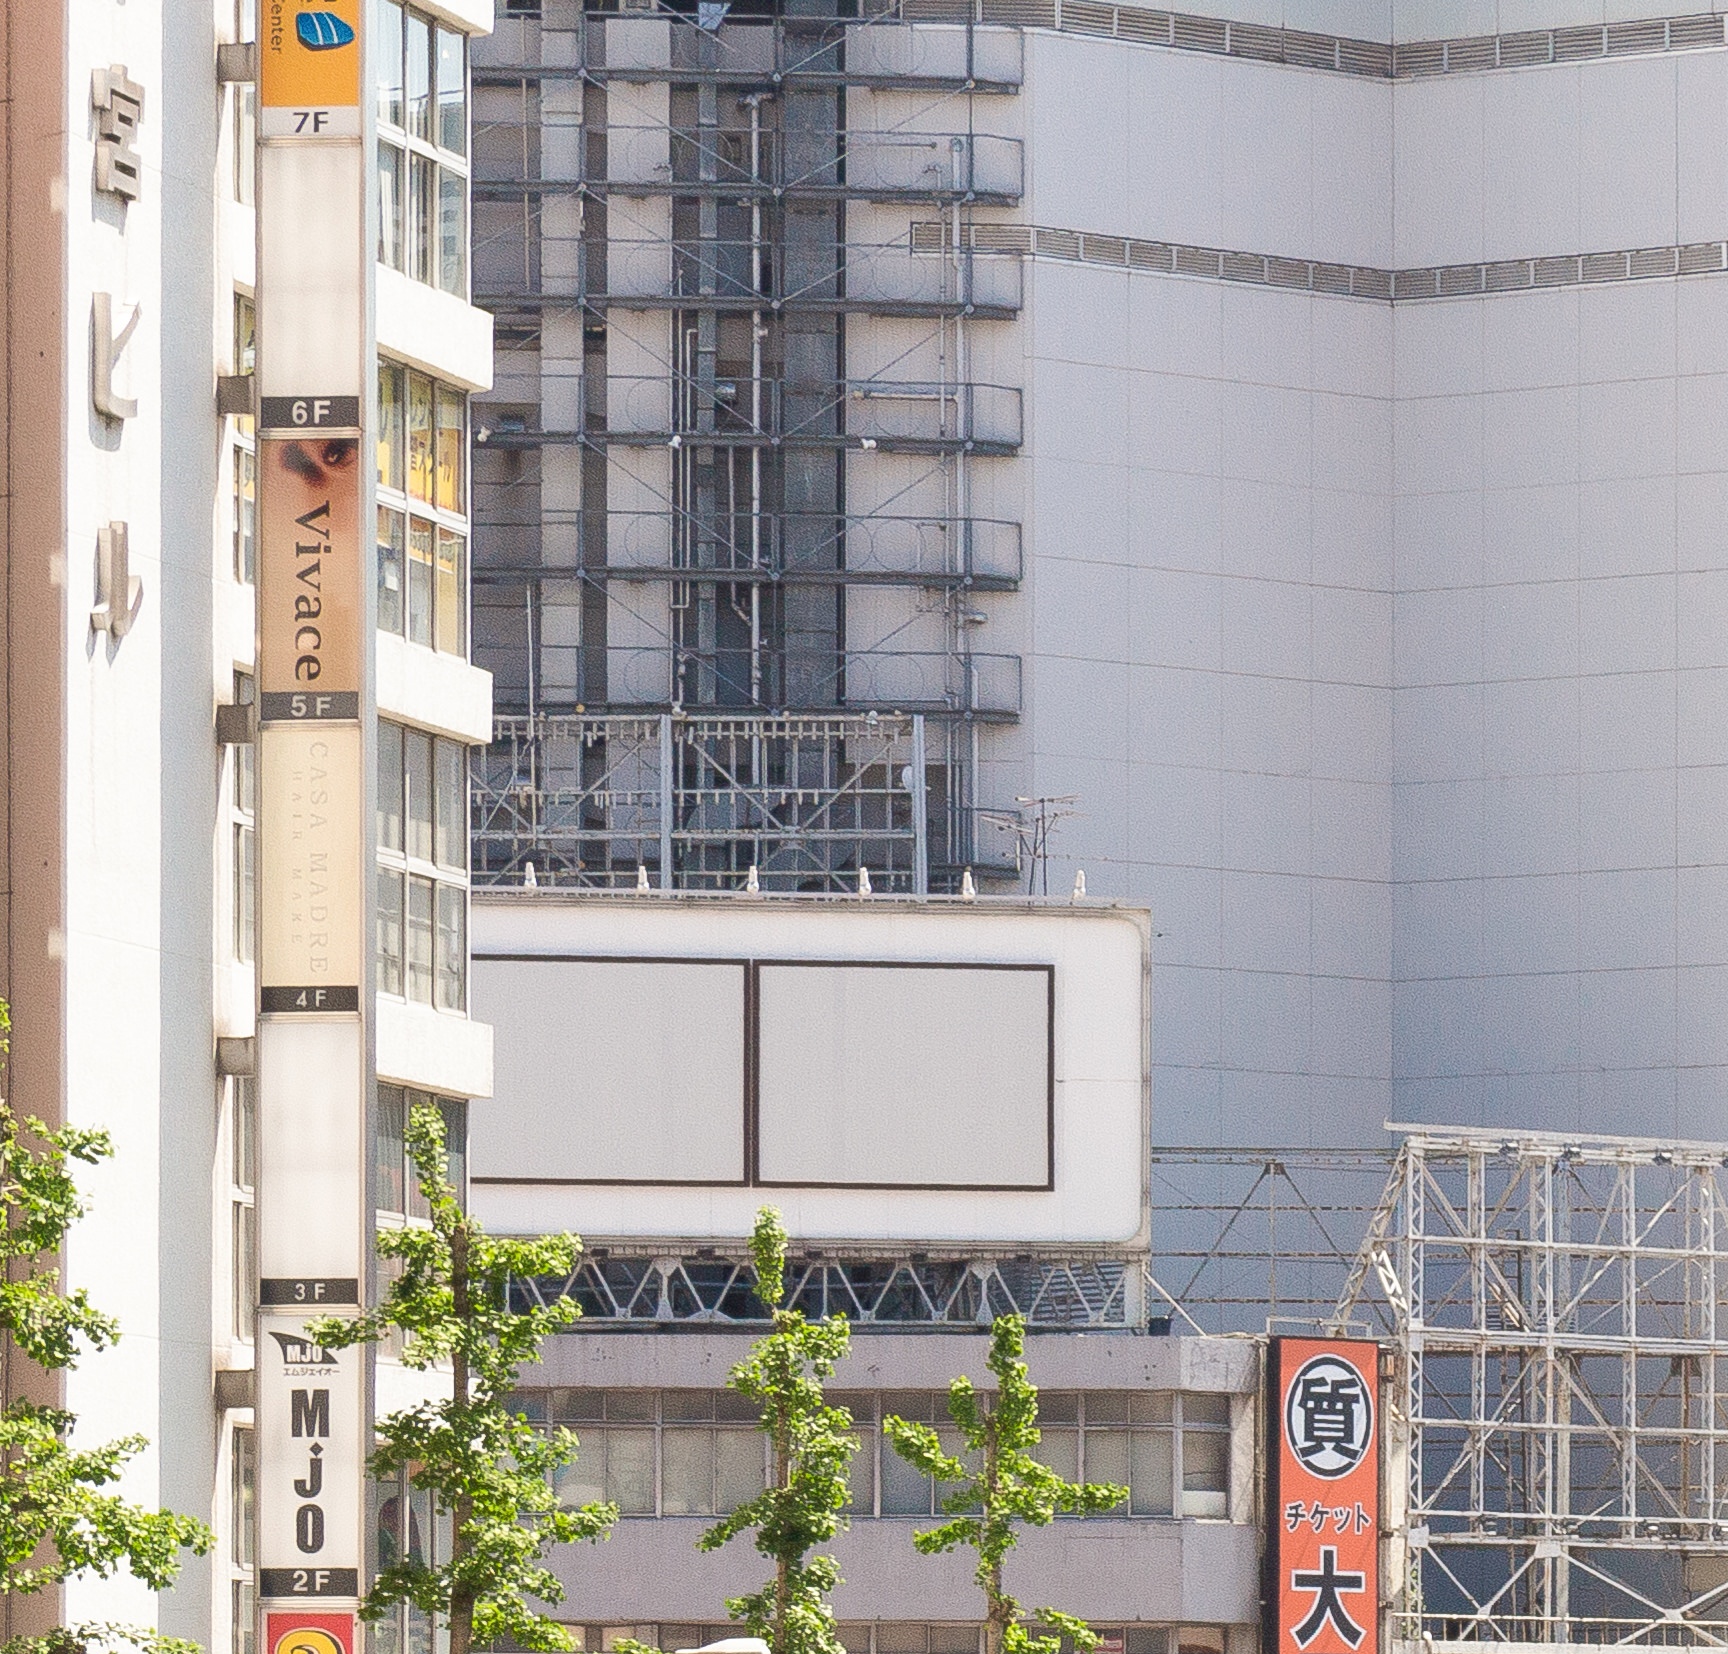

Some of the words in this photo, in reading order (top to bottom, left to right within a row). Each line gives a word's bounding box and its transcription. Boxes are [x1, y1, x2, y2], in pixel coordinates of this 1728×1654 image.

[293, 111, 329, 133] 7F
[291, 401, 331, 425] 6F
[294, 500, 331, 682] Vivace
[290, 695, 331, 717] 5F
[309, 741, 329, 829] CASA
[309, 852, 329, 974] MADRE
[296, 989, 327, 1007] 4F
[295, 1283, 326, 1300] 3F
[1300, 1377, 1363, 1464] 質
[1286, 1501, 1370, 1534] チケット
[293, 1571, 330, 1591] 2F
